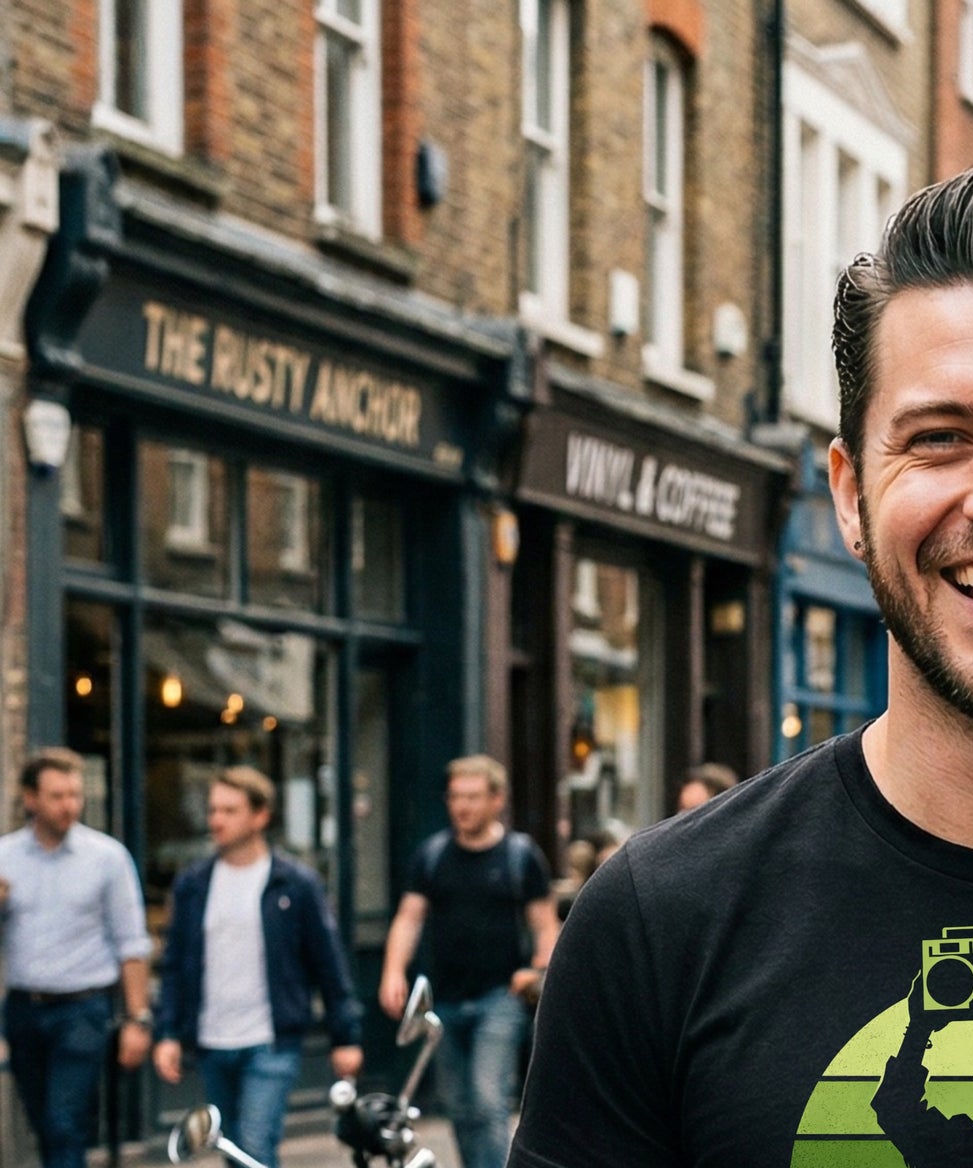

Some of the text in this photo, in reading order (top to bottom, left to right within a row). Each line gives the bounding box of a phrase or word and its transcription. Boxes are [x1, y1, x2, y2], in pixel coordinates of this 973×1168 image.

[142, 301, 421, 446] THE RUSTY ANCHOR
[566, 432, 634, 511] VINYL
[656, 463, 741, 540] COFFEE
